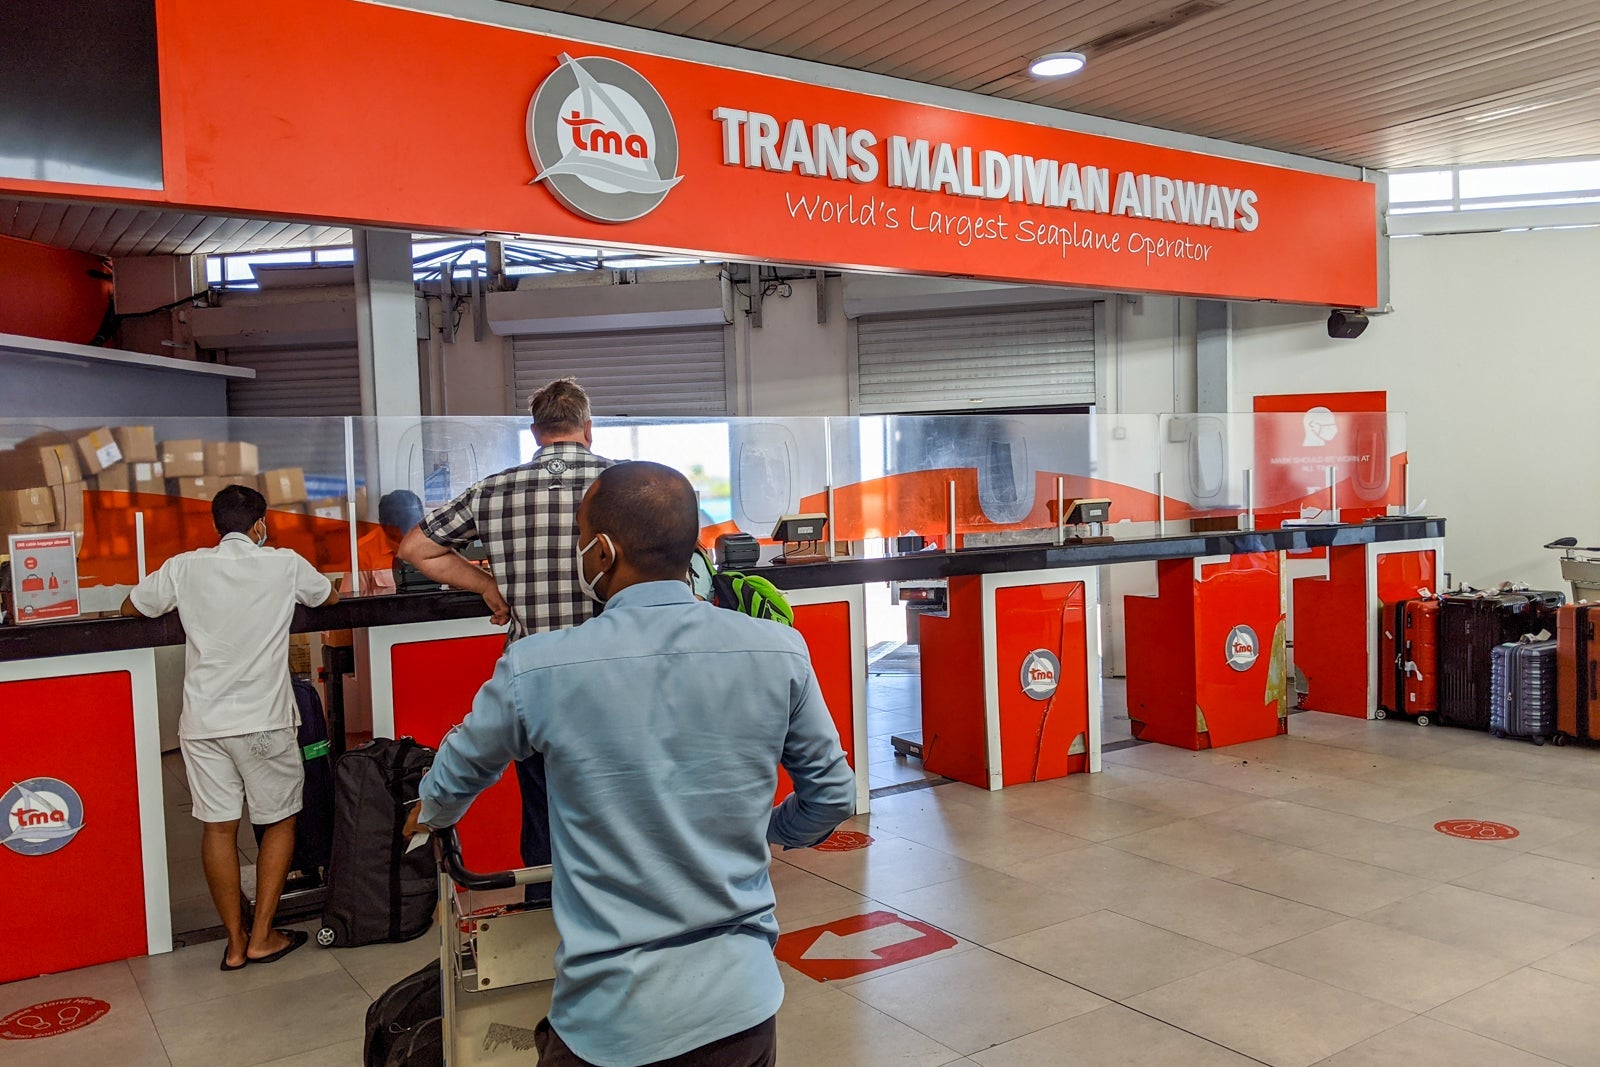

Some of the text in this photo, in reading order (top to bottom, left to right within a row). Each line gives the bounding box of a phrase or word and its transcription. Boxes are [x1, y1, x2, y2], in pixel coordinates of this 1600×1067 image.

[562, 111, 648, 159] tma
[713, 106, 1260, 233] TRANS MALDIVIAN AIRWAYS
[786, 191, 1213, 266] World's Largest Seaplane Operator
[1231, 642, 1253, 653] tma
[1029, 668, 1054, 681] tma
[10, 808, 65, 827] tma
[34, 999, 72, 1010] Stand
